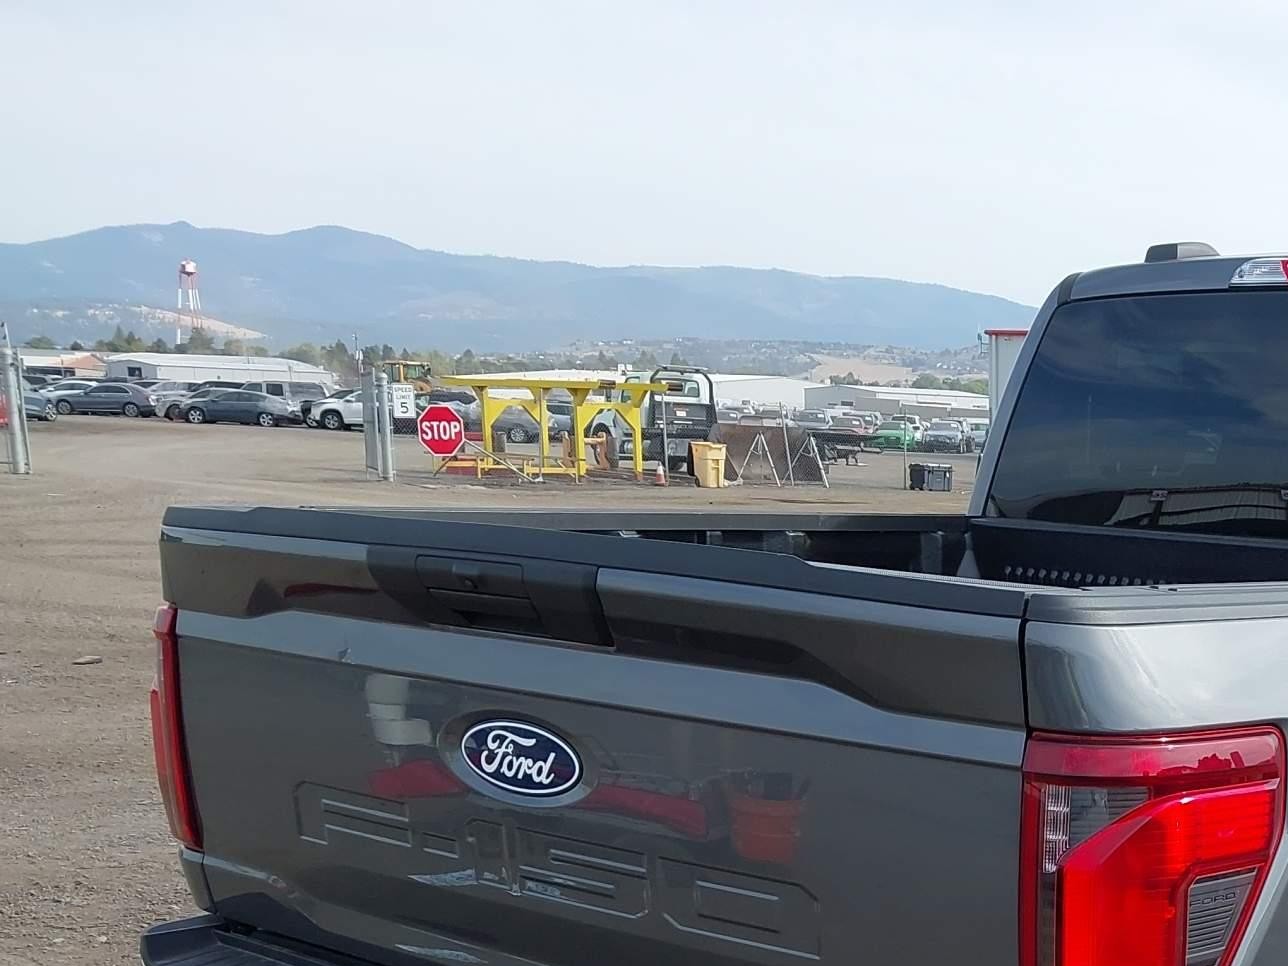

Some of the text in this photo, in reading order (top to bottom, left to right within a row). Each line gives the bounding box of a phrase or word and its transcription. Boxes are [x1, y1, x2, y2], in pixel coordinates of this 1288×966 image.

[400, 401, 409, 414] 5
[421, 421, 460, 440] STOP
[480, 729, 556, 785] Ford
[293, 780, 822, 960] F-150
[1190, 892, 1236, 907] FORD
